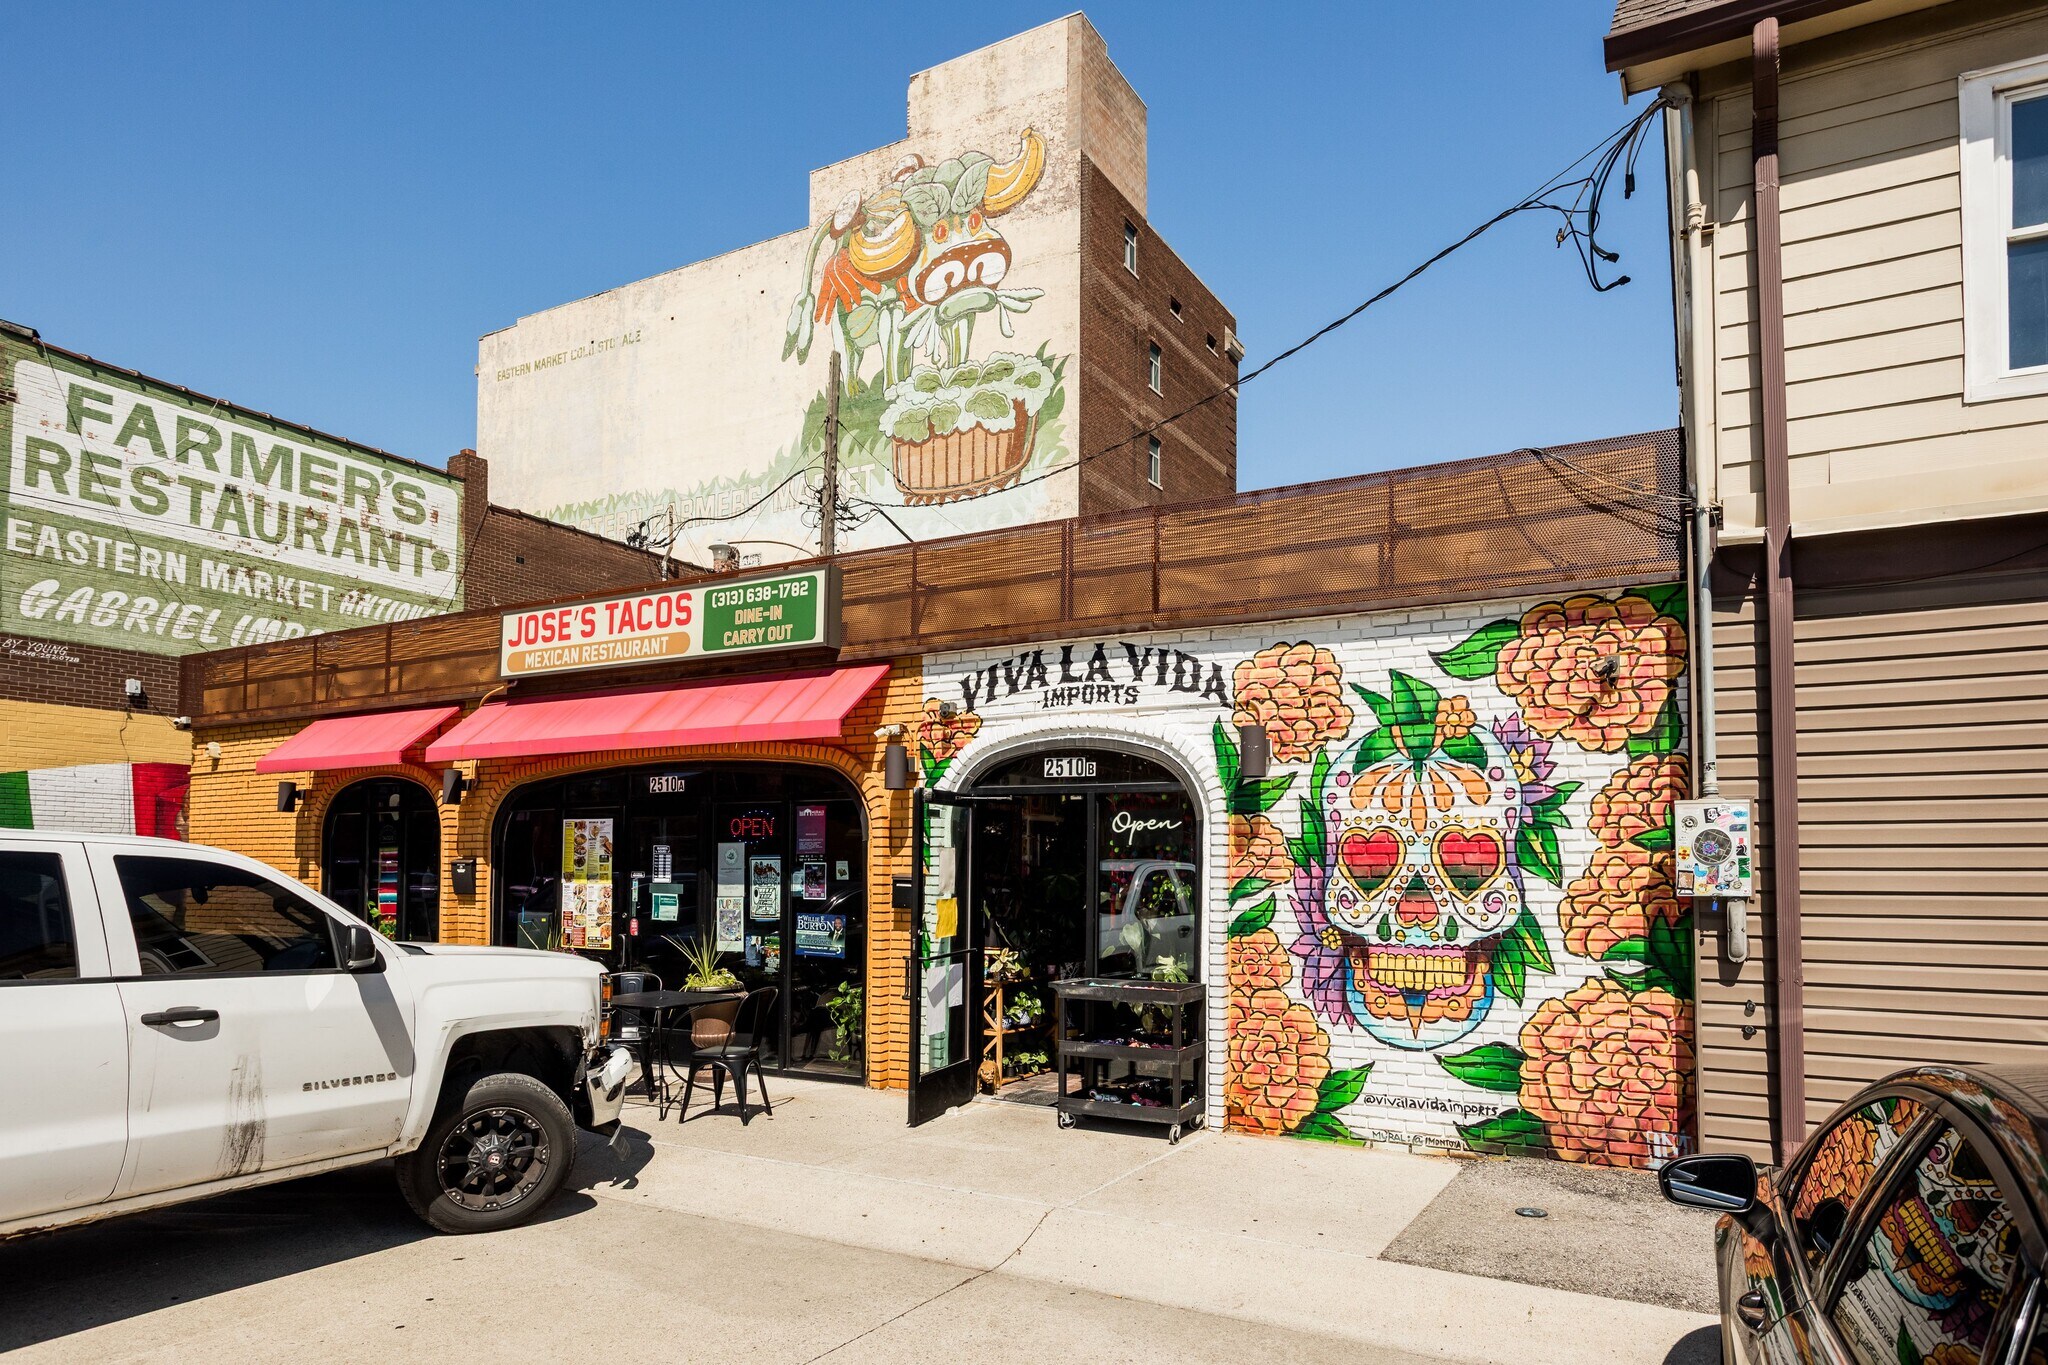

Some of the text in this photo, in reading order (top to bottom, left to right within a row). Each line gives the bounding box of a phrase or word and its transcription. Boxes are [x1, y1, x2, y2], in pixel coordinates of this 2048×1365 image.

[497, 362, 531, 382] EASTERN
[534, 351, 568, 371] MARKET
[66, 382, 427, 525] FARMER'S
[6, 518, 187, 584] EASTERN
[201, 559, 335, 611] MARKET
[711, 580, 809, 608] (313) 638-1782
[19, 579, 222, 643] GABRIEL
[507, 592, 693, 647] JOSE'S TACOS
[734, 605, 783, 626] DINE-IN
[2, 638, 69, 656] BY YOUNG
[723, 624, 793, 647] CARRY OUT
[525, 636, 669, 669] MEXICAN RESTAURANT
[958, 641, 1236, 713] VIVA LA VIDA
[1041, 684, 1141, 710] IMPORTS
[730, 818, 774, 836] OPEN
[1111, 811, 1182, 846] Open
[797, 920, 835, 932] BURTON
[302, 1072, 397, 1092] SILVERADO
[1363, 1093, 1500, 1119] @vivalavidaimports
